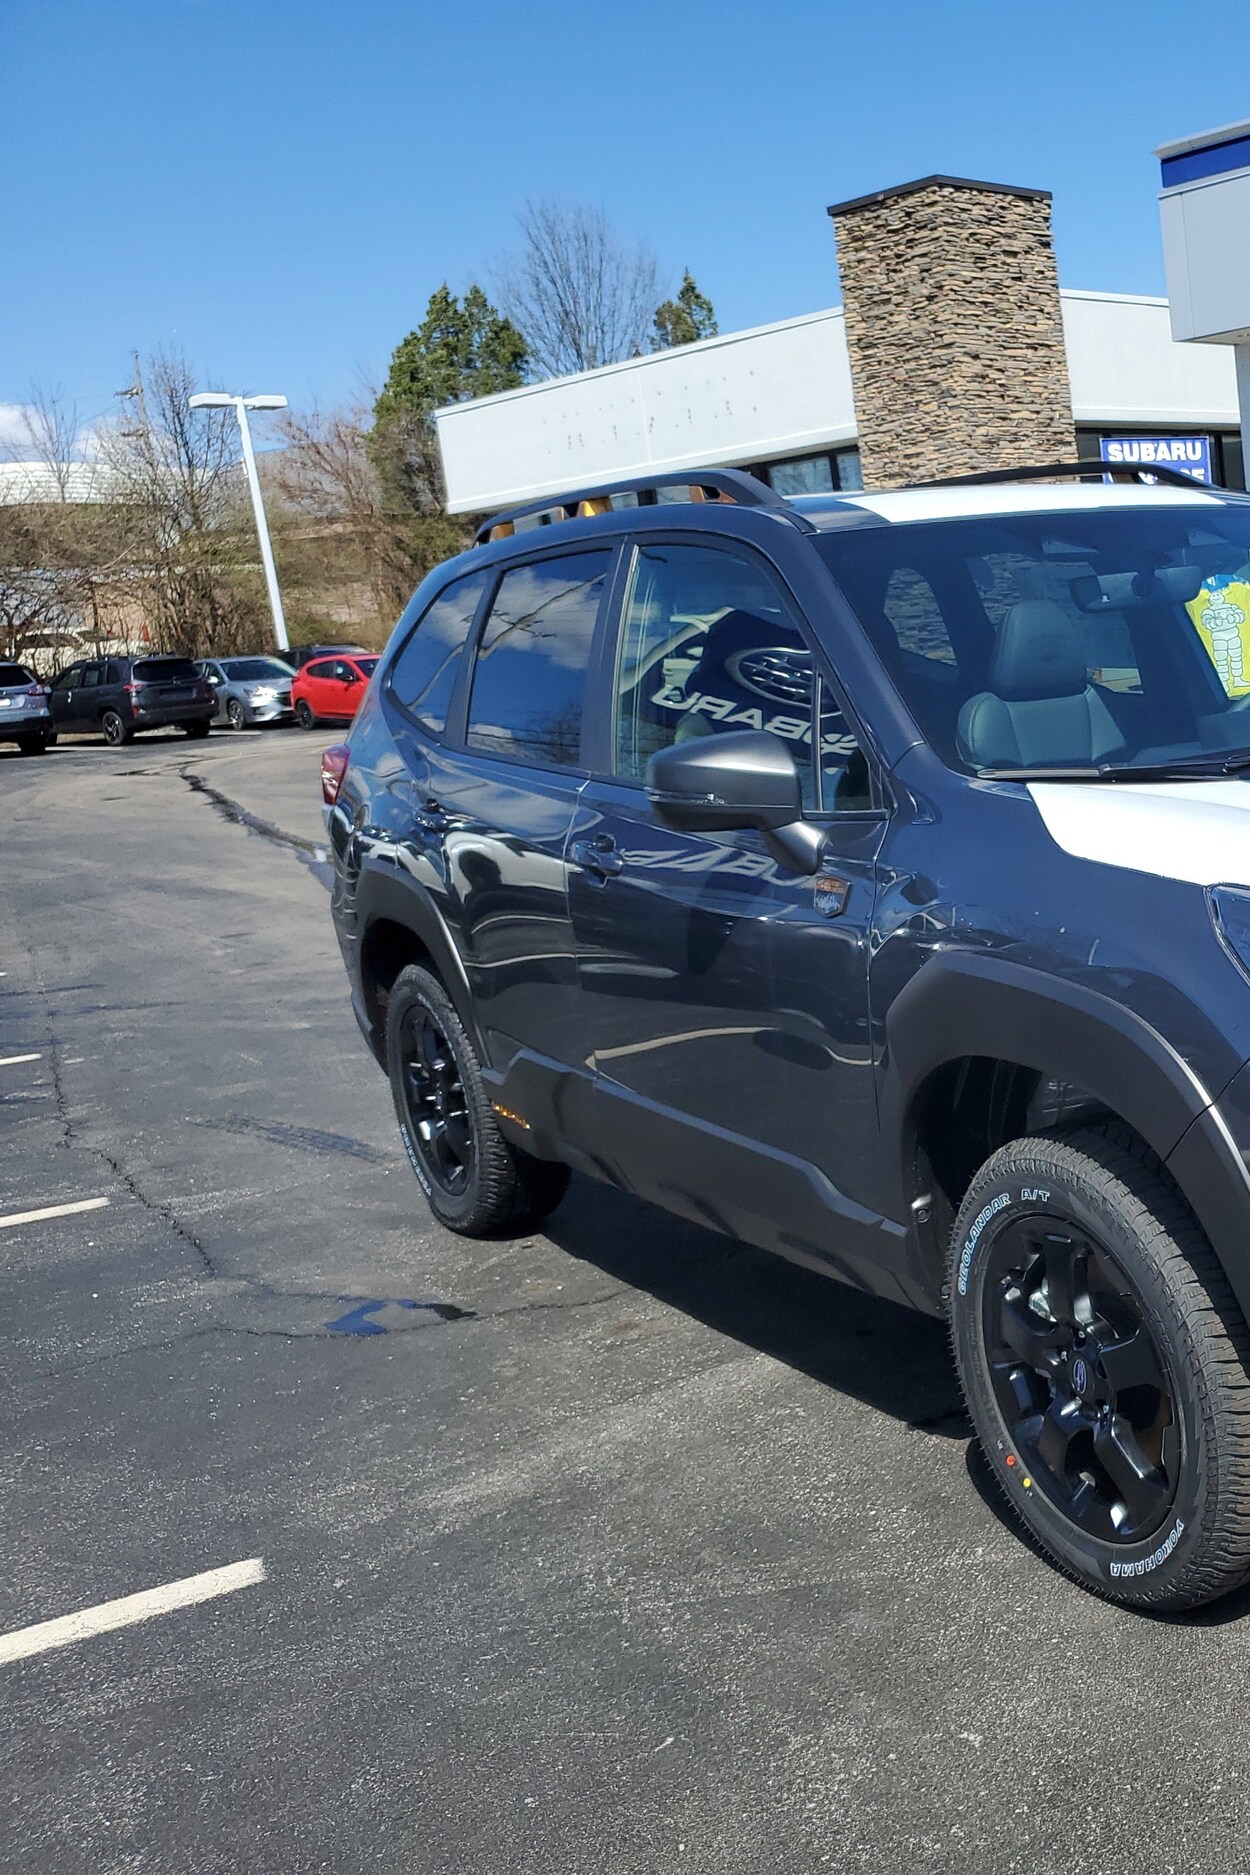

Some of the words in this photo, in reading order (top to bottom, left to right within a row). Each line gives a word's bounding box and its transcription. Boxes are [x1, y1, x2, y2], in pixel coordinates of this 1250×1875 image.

[1107, 440, 1203, 462] SUBARU
[958, 1192, 1011, 1296] GEOLANDAR
[1021, 1188, 1051, 1202] A/T
[1109, 1517, 1185, 1577] YOKOHAMA
